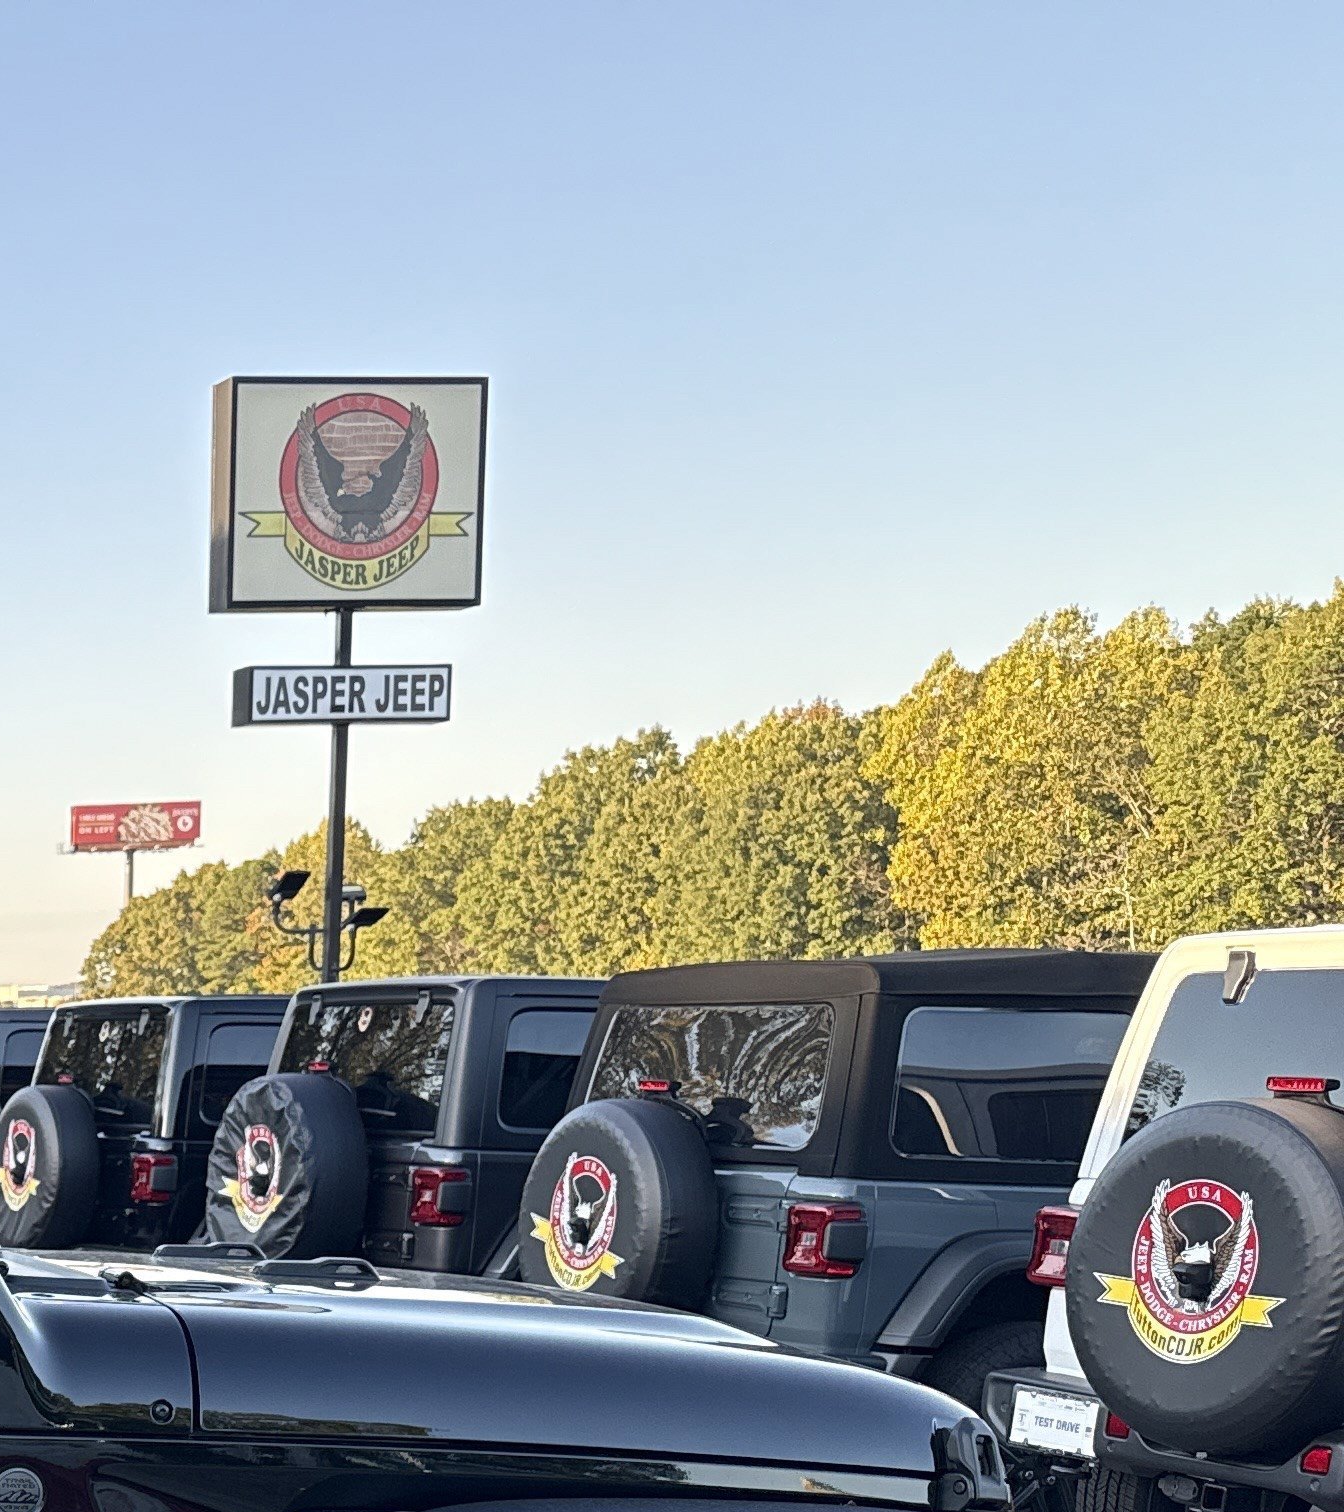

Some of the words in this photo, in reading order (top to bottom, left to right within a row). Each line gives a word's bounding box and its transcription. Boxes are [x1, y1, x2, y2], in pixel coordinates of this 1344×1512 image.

[295, 538, 368, 586] JASPER
[372, 533, 421, 583] JEEP
[256, 676, 366, 715] JASPER
[375, 674, 445, 713] JEEP
[583, 1160, 603, 1177] USA
[1187, 1186, 1222, 1203] USA
[1136, 1235, 1150, 1276] JEEP
[1239, 1248, 1254, 1286] RAM
[1140, 1282, 1175, 1326] DODGE
[1178, 1292, 1242, 1332] CHRYSLER
[1034, 1415, 1055, 1429] TEST
[1056, 1420, 1081, 1434] DRIVE
